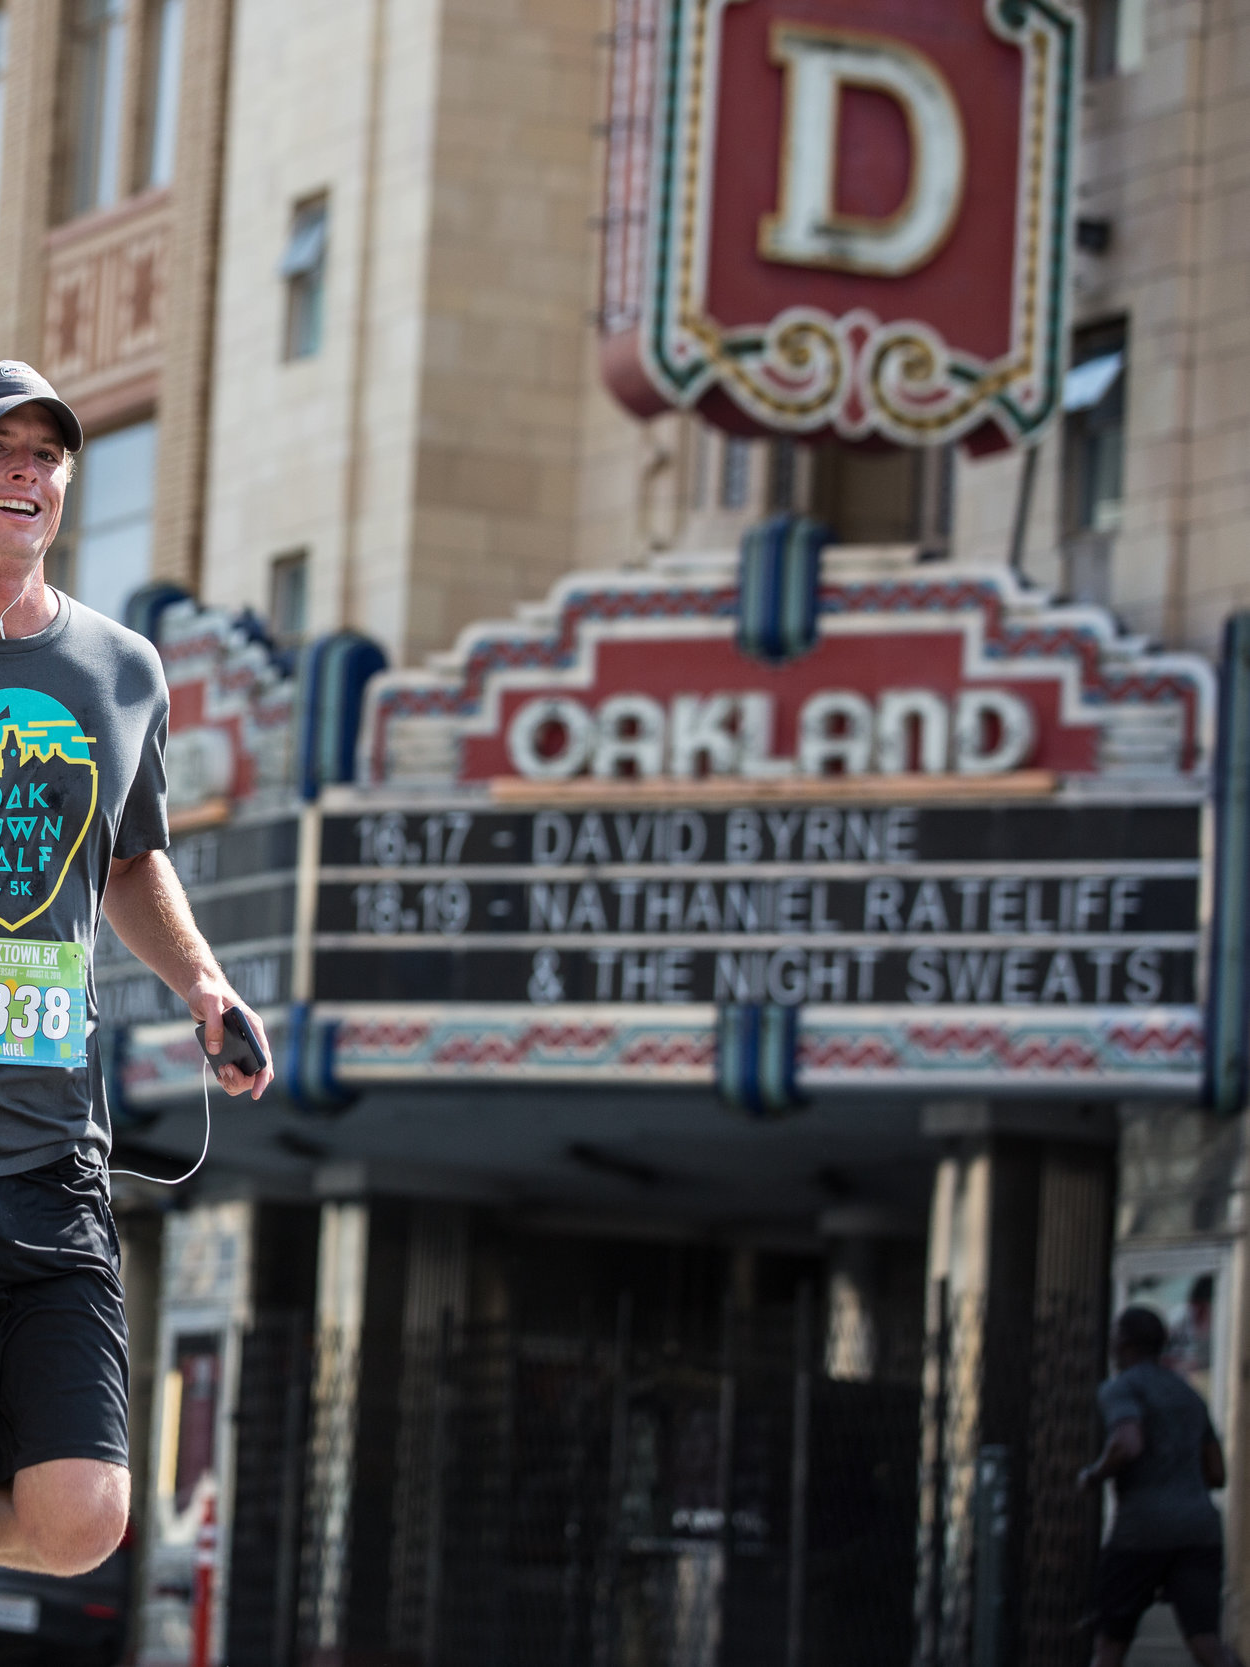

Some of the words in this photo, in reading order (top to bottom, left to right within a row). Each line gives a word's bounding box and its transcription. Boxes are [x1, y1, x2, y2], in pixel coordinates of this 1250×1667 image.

[758, 20, 966, 278] D
[507, 689, 1036, 780] OAKLAND
[531, 810, 709, 866] DAVID
[724, 807, 920, 864] BYRNE
[10, 881, 33, 896] 5K
[527, 878, 843, 935] NATHANIEL
[864, 877, 1146, 934] RATELIFF
[43, 948, 59, 965] 5K
[527, 946, 565, 1003] &
[589, 945, 696, 1002] THE
[713, 944, 883, 1002] NIGHT
[905, 944, 1164, 1002] SWEATS
[3, 1043, 26, 1056] KIEL
